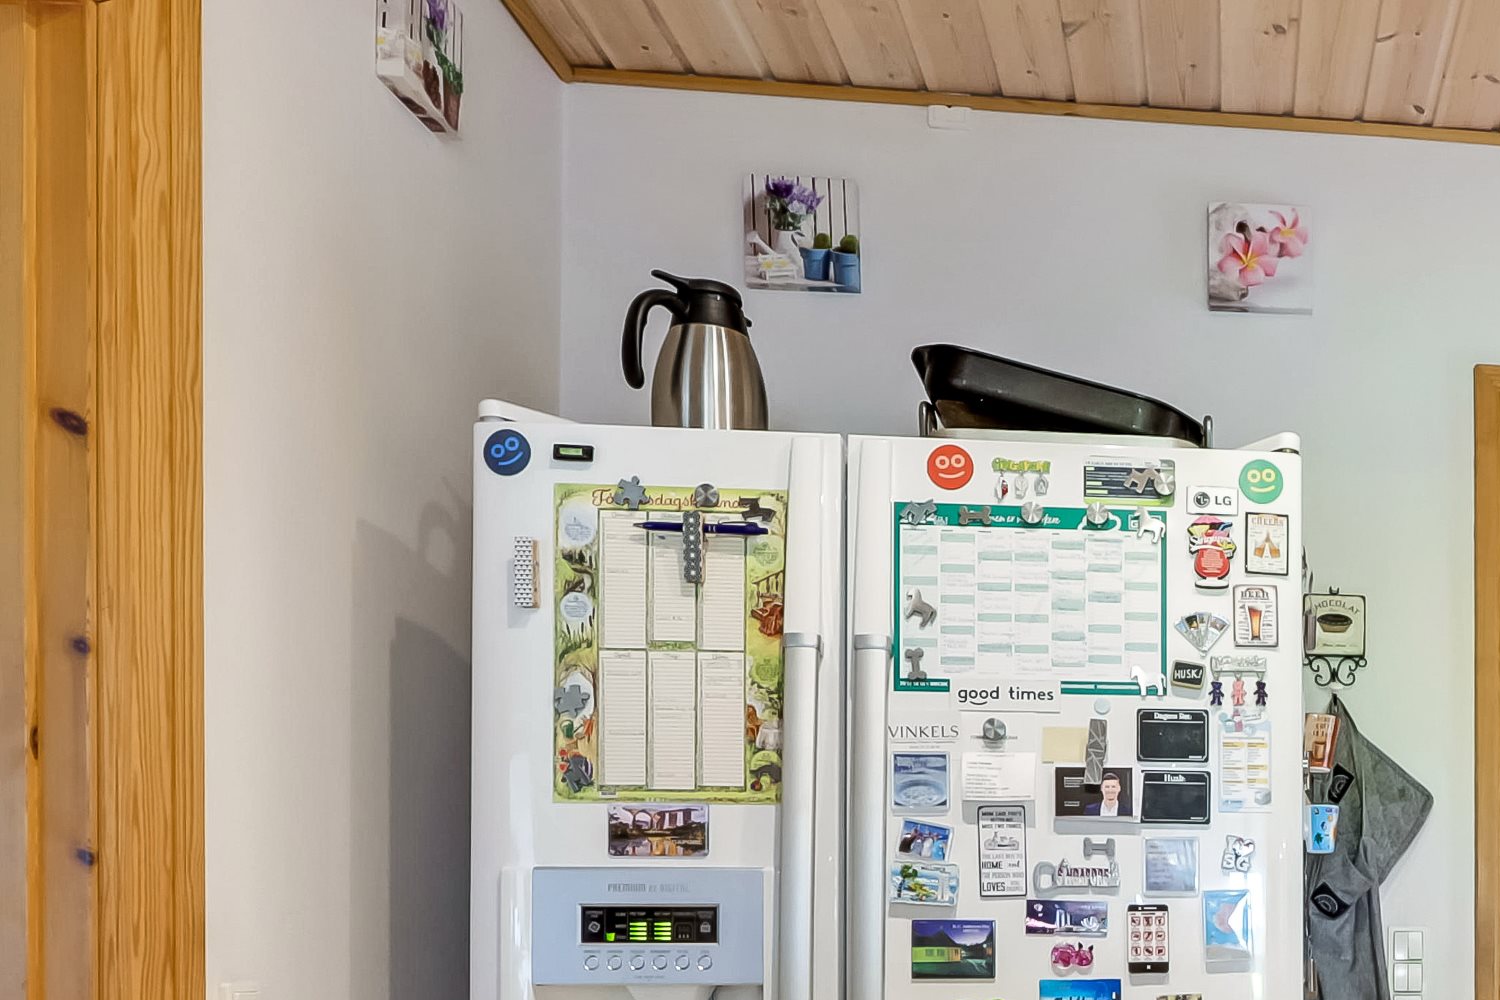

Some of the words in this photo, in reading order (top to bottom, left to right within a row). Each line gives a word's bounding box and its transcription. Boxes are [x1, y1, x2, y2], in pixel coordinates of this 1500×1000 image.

[1215, 496, 1232, 506] LG
[1240, 591, 1269, 599] BEER
[1313, 599, 1361, 616] HOCOLAT
[958, 686, 1000, 703] good
[1008, 686, 1054, 701] times
[887, 725, 959, 739] VINKELS
[982, 861, 1003, 869] HOME
[982, 882, 1005, 892] LOVES
